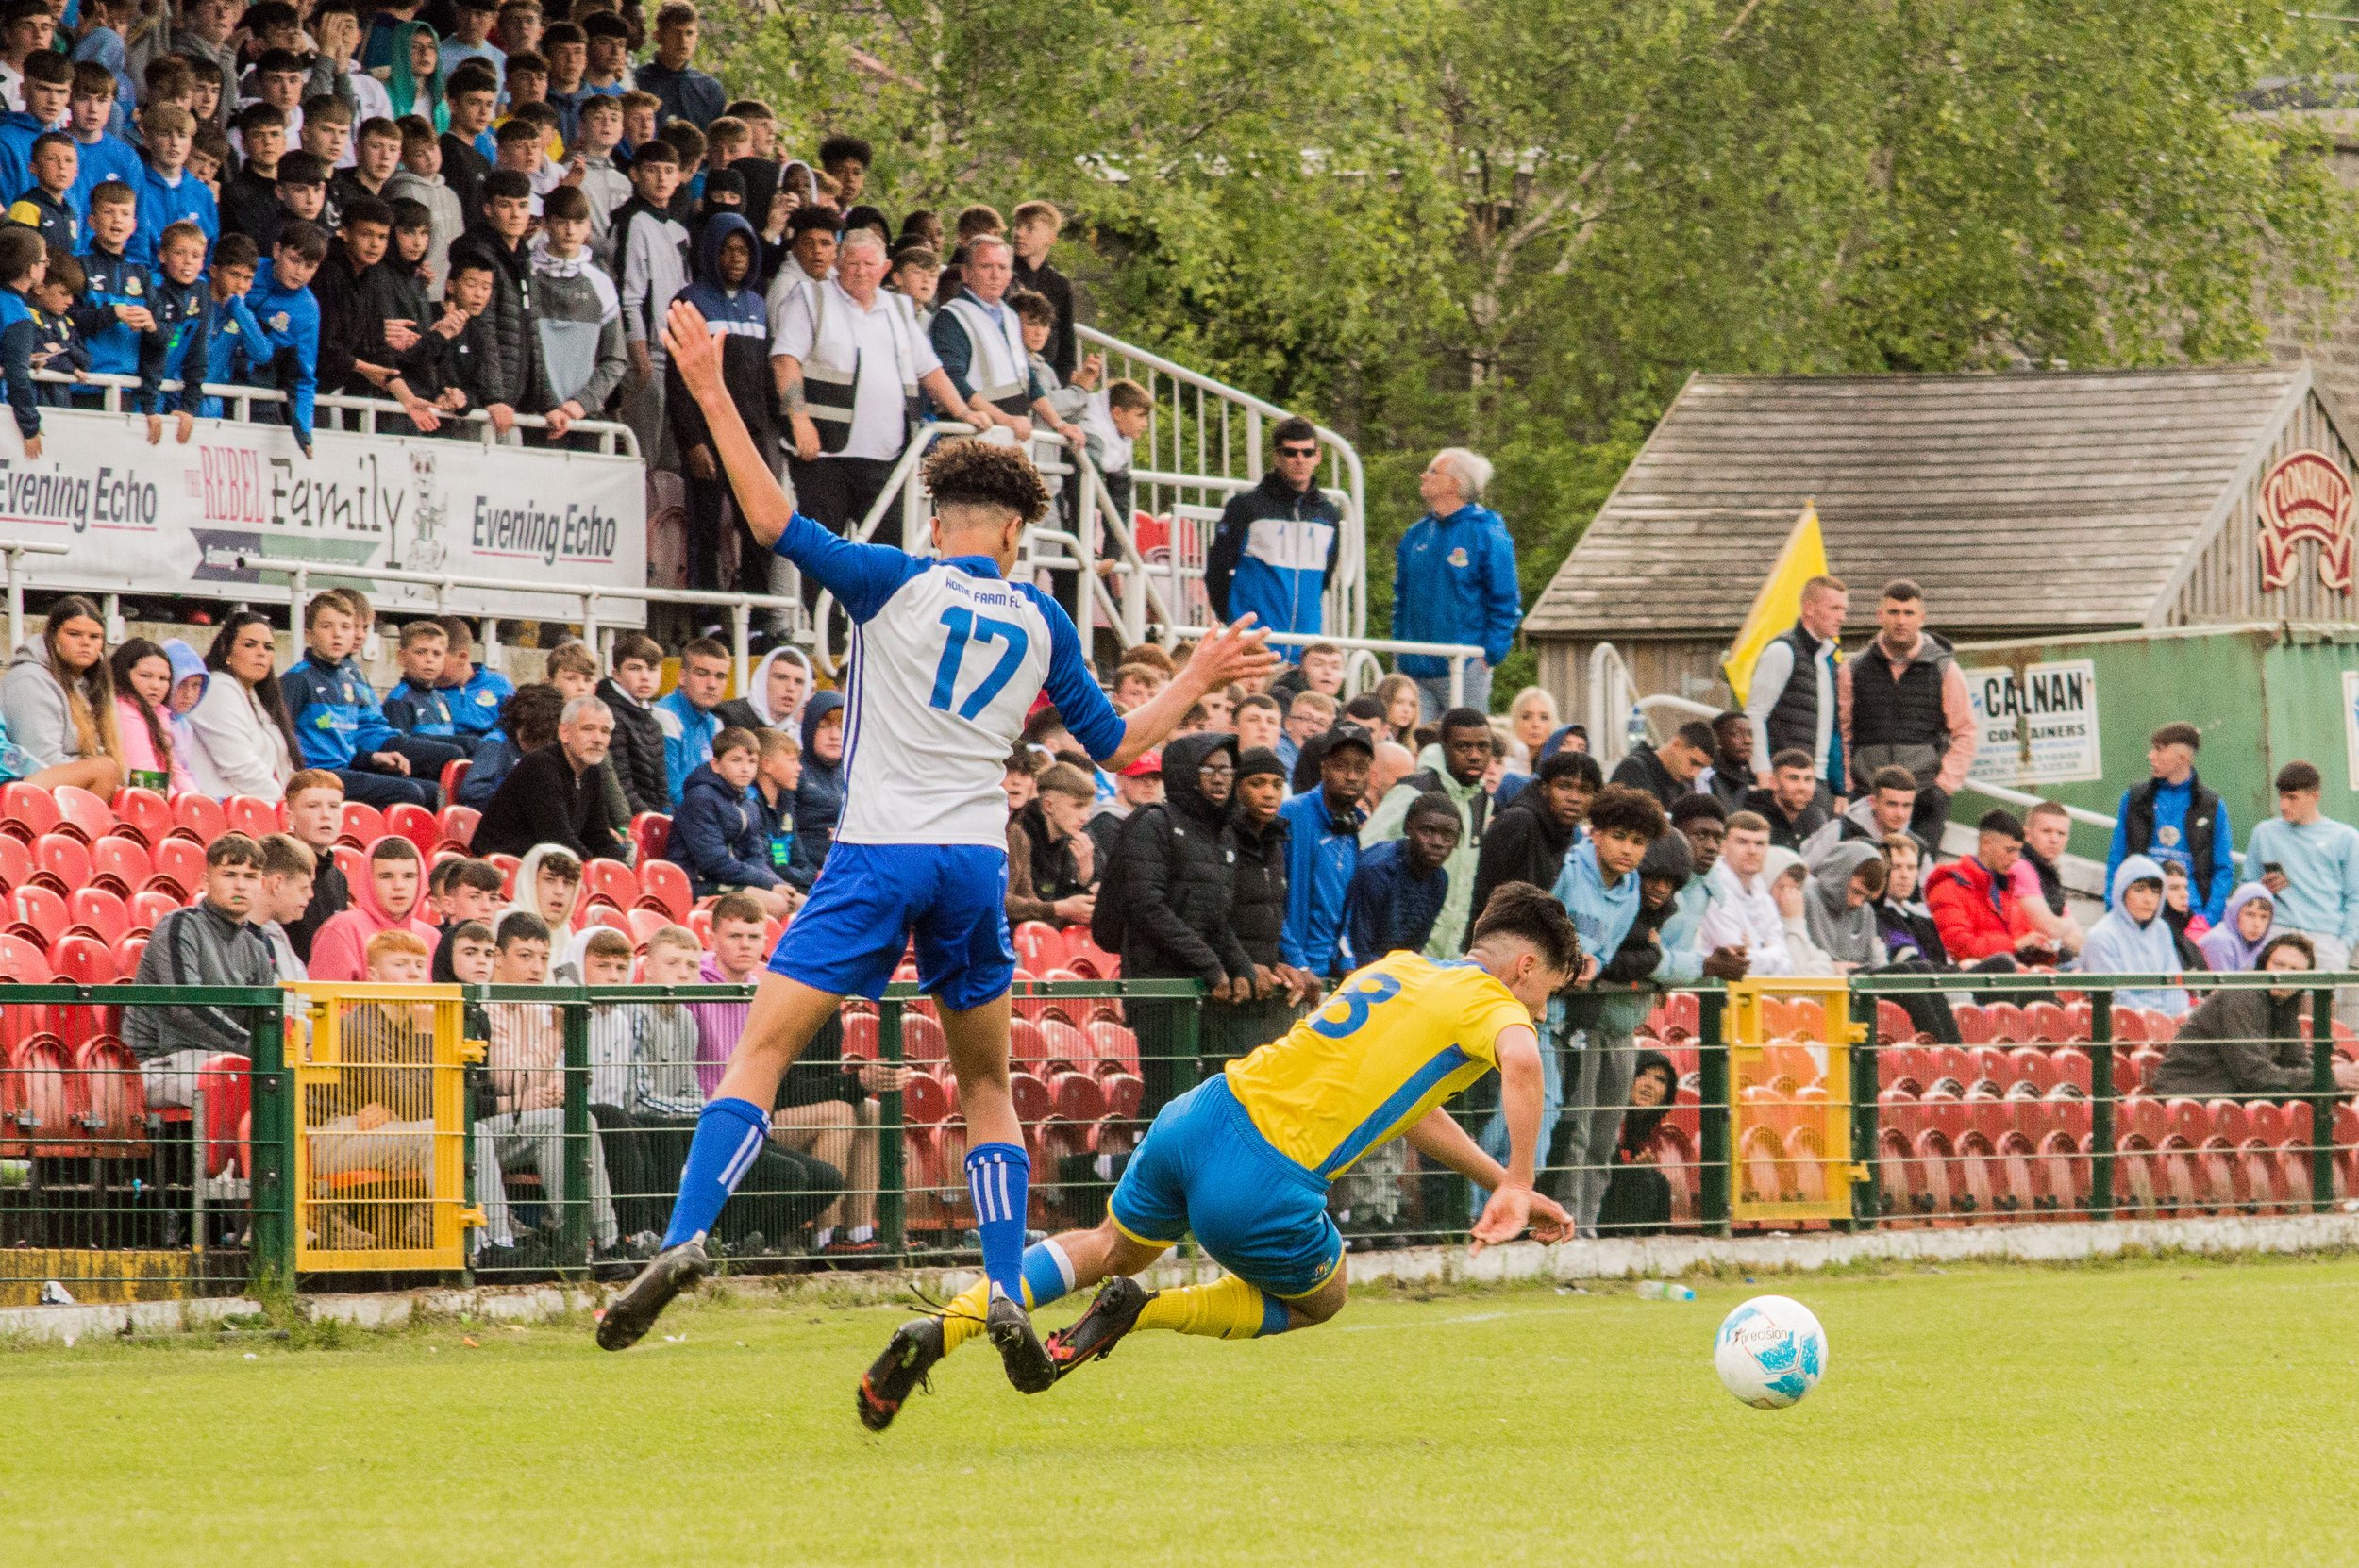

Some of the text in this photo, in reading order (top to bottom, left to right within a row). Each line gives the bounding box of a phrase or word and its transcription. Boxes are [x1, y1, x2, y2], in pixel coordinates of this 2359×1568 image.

[94, 467, 157, 525] Echo
[199, 445, 265, 523] REBEL
[269, 453, 405, 569] Family
[473, 495, 616, 566] Evening Echo
[974, 592, 1006, 606] FARM
[929, 606, 1029, 722] 17
[1984, 672, 2084, 718] CALNAN
[1987, 724, 2087, 743] CONAINERS
[1308, 972, 1402, 1039] 8
[1740, 1327, 1788, 1345] precision
